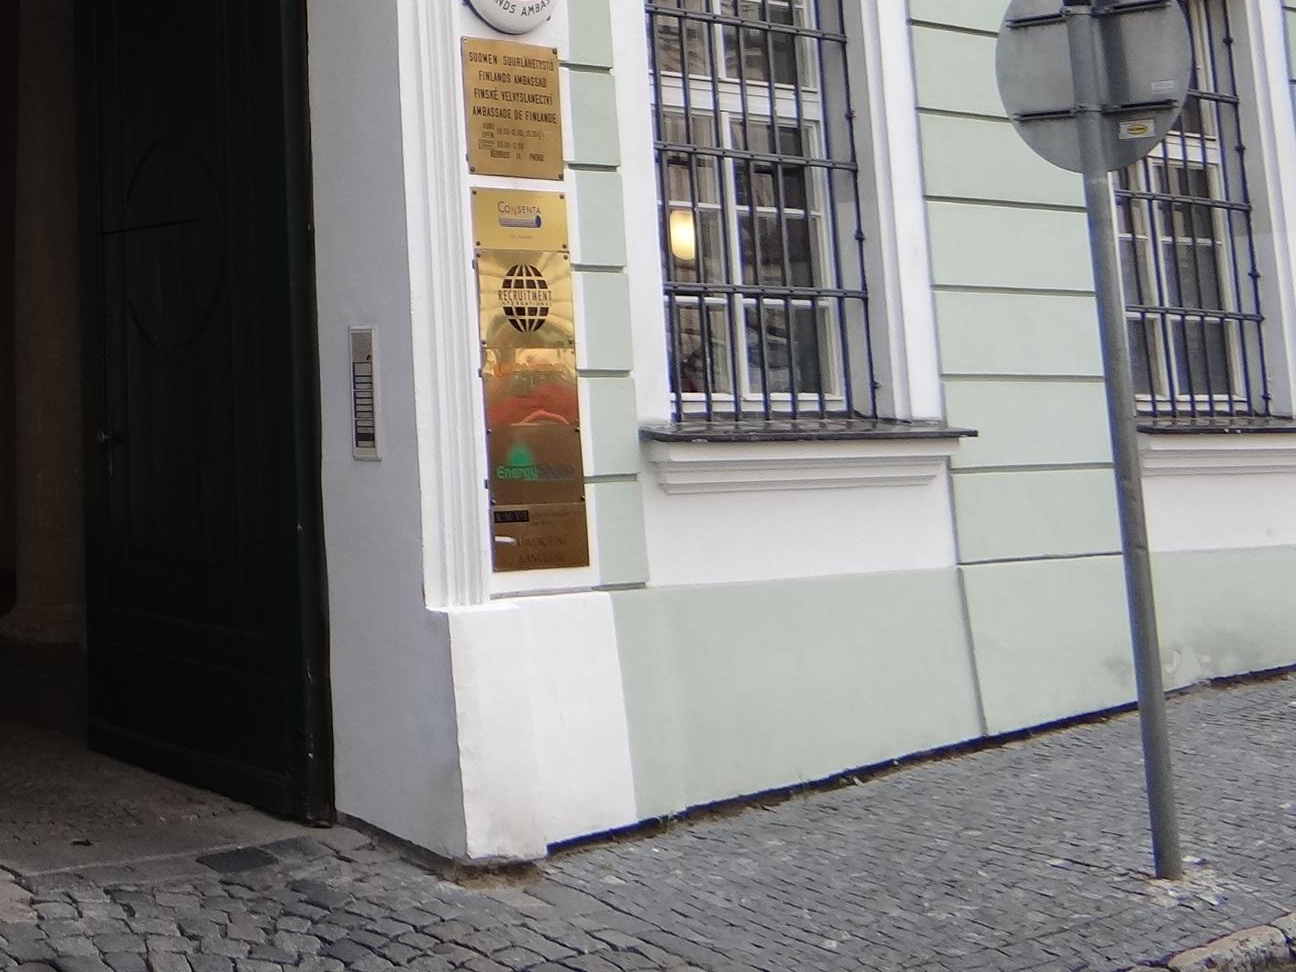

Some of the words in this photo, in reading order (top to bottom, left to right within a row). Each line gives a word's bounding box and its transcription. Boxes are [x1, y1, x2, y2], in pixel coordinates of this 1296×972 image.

[468, 51, 498, 64] SUOMEN
[478, 70, 511, 83] FINLANDS
[514, 74, 547, 88] AMBASSAD
[474, 87, 499, 101] FINSKÉ
[472, 105, 511, 119] AMBASSADE
[514, 109, 522, 120] DE
[525, 110, 557, 123] FINLANDE
[497, 290, 552, 301] RECRUITMENT
